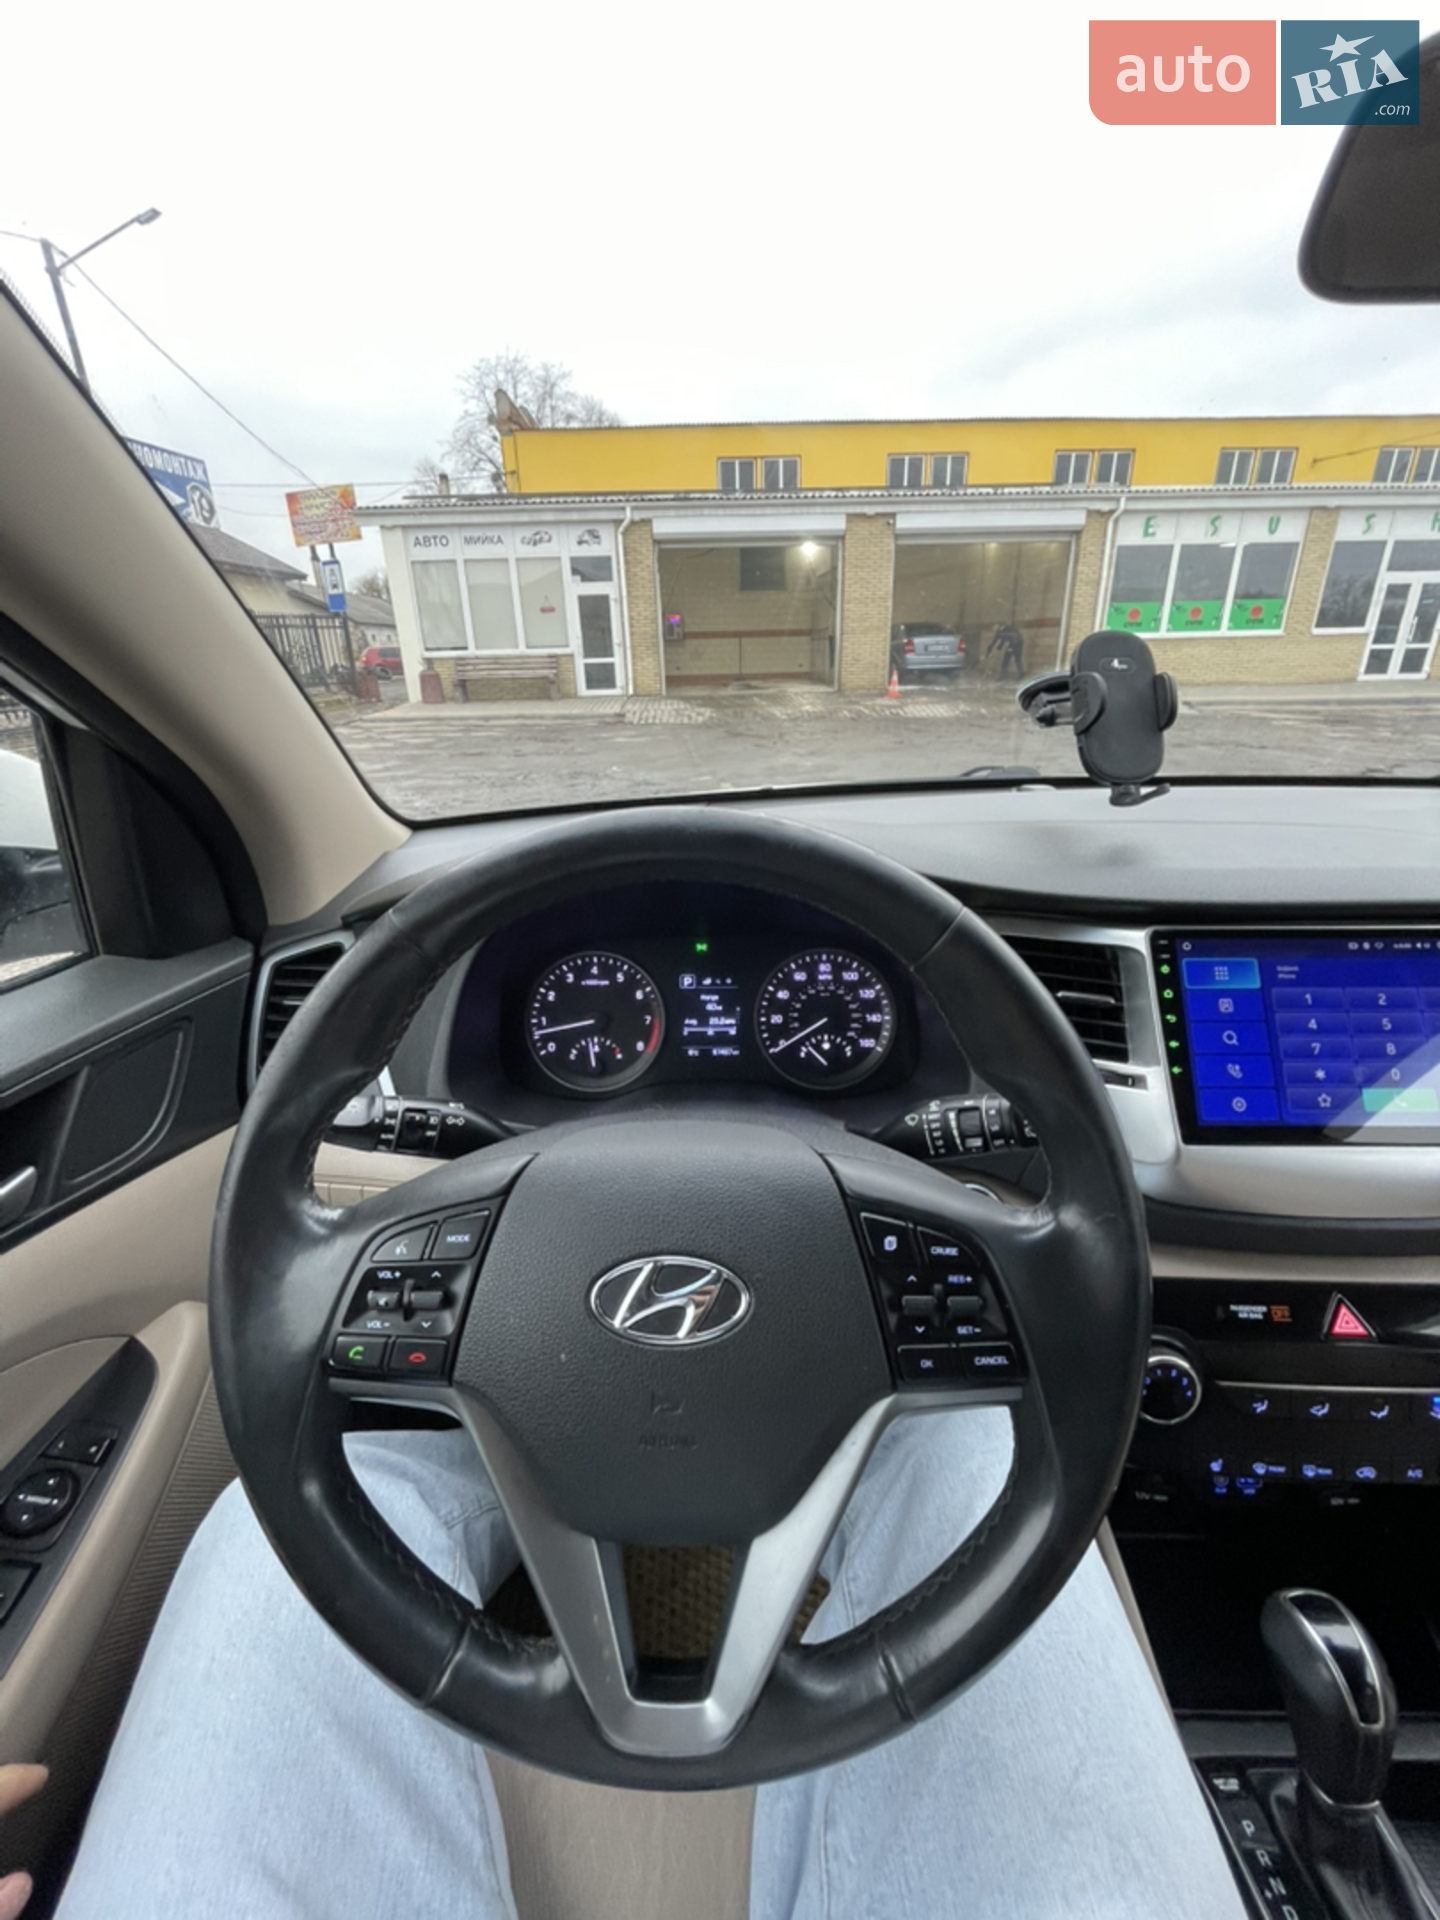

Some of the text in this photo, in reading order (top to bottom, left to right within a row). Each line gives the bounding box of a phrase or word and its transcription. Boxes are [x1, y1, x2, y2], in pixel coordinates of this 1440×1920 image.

[127, 442, 207, 483] НОМОНТАЖ
[413, 533, 504, 549] АВТО МИЙКА
[590, 965, 599, 975] 4
[565, 972, 574, 983] 3
[616, 972, 625, 983] 5
[683, 976, 692, 988] P
[547, 991, 555, 1001] 2
[635, 989, 644, 1000] 6
[1305, 993, 1387, 1006] 1 2
[541, 1016, 547, 1026] 1
[643, 1015, 652, 1025] 7
[1308, 1018, 1392, 1030] 4 5
[547, 1042, 556, 1053] 0
[1311, 1042, 1396, 1055] 7 8
[1391, 1068, 1400, 1080] 0
[447, 1234, 471, 1243] MODE
[931, 1246, 959, 1257] CRUISE
[920, 1360, 934, 1369] OK
[974, 1356, 1009, 1366] CANCEL
[1242, 1820, 1256, 1837] P
[1256, 1850, 1272, 1868] R
[1269, 1876, 1287, 1896] N
[1283, 1905, 1299, 1920] D
